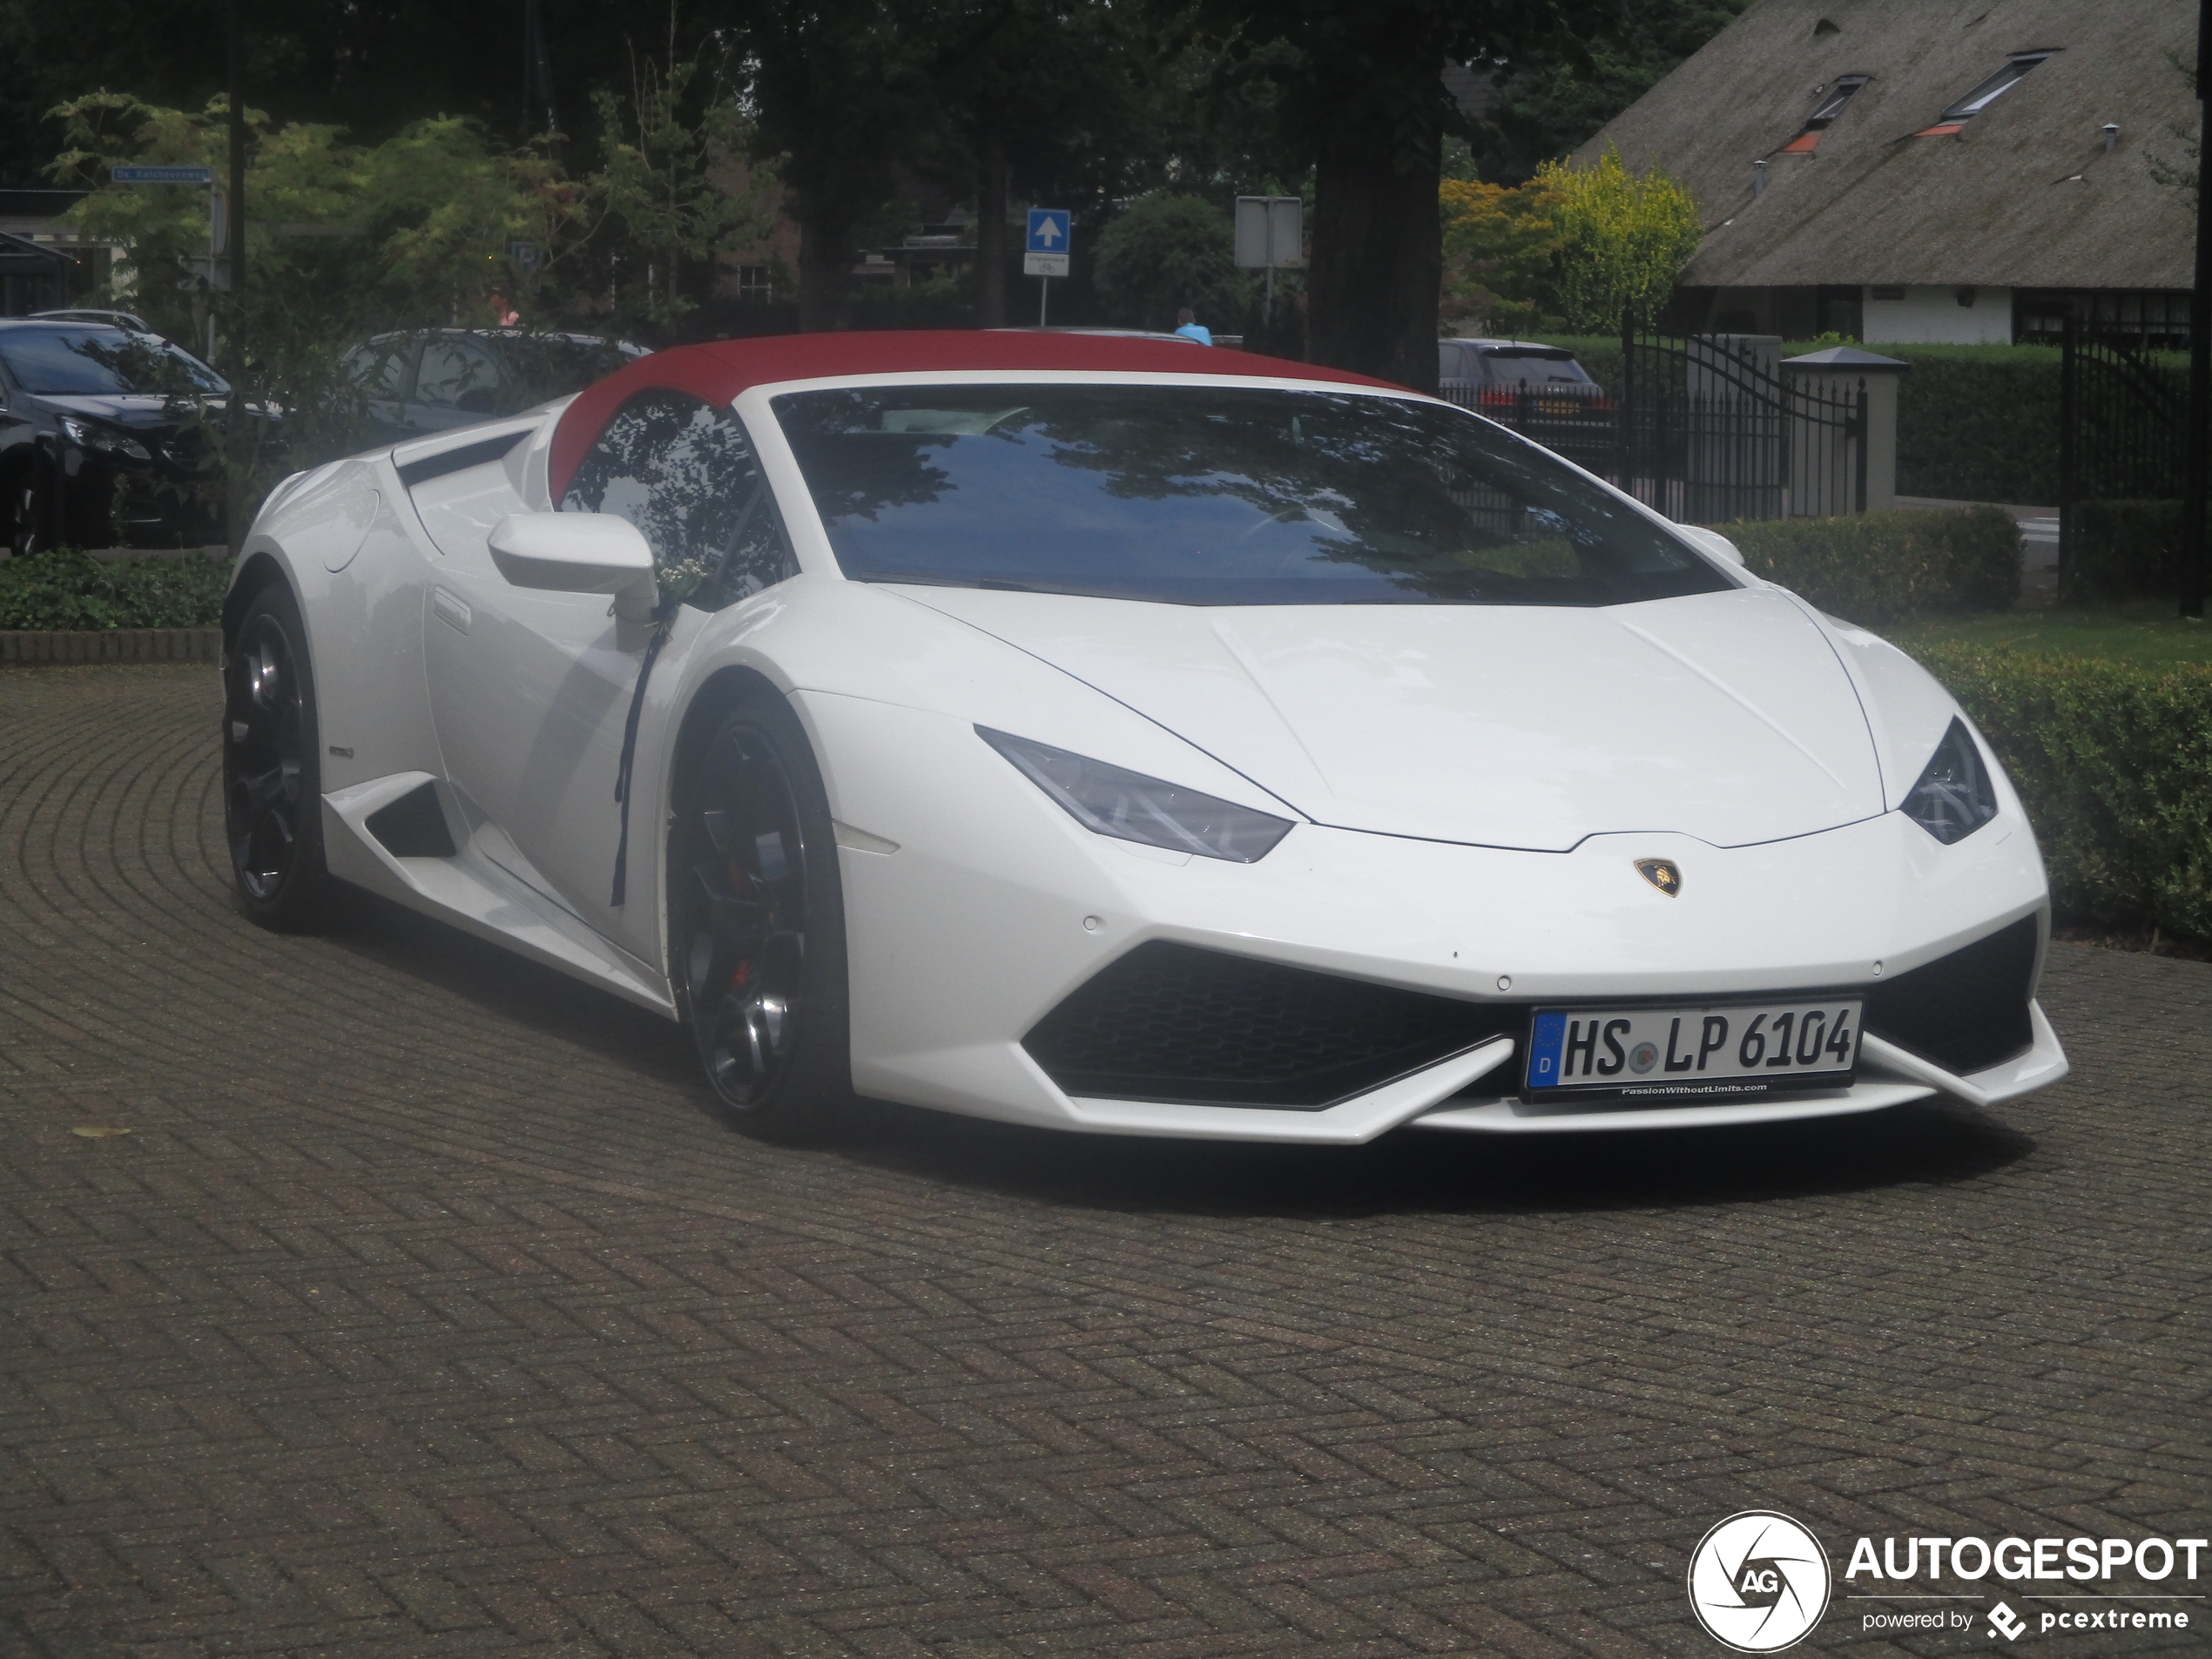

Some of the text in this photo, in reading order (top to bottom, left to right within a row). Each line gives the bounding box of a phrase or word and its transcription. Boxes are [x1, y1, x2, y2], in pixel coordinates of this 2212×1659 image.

[1539, 1008, 1851, 1076] D HS LP 6104
[1622, 1083, 1768, 1095] PassionWithoutLimits.com
